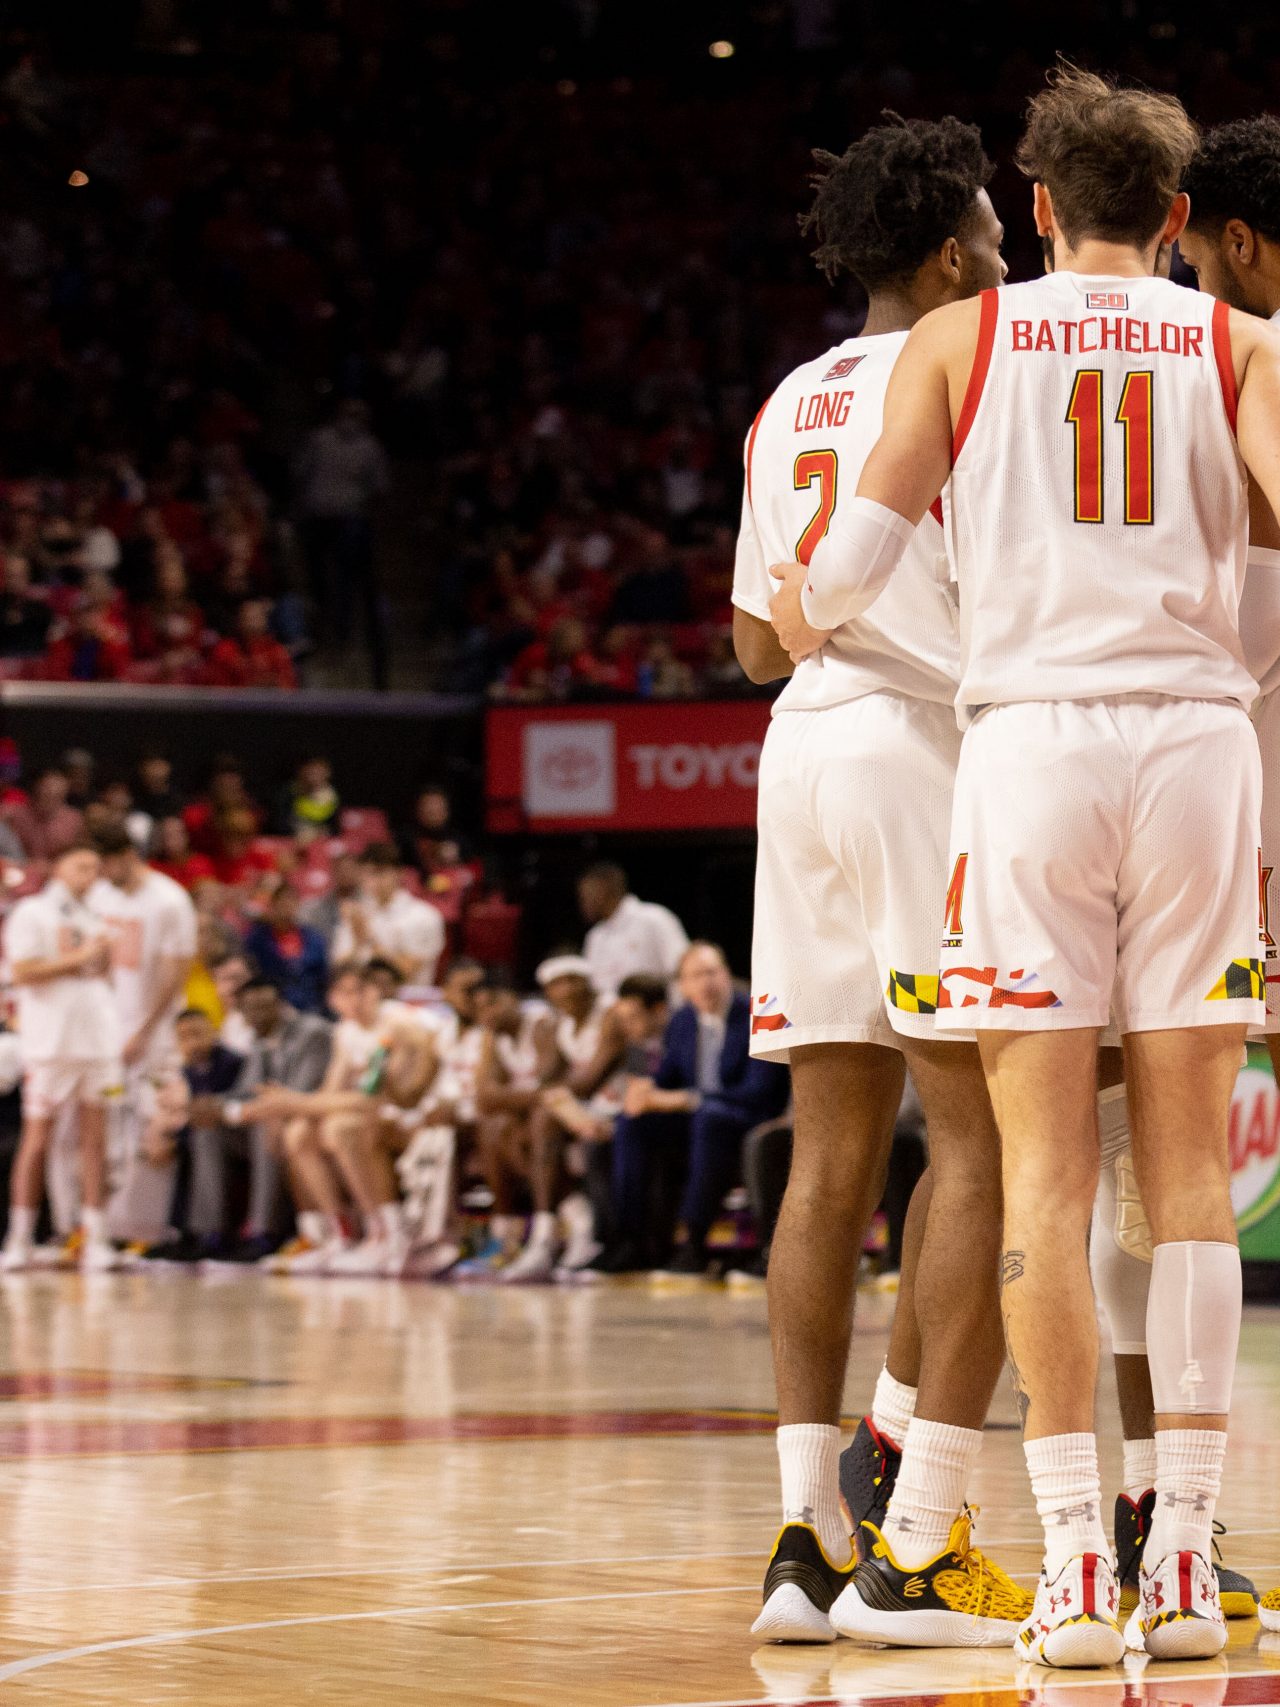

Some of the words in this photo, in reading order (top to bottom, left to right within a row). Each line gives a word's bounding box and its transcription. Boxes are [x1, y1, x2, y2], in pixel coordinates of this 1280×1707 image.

[1089, 293, 1126, 308] 50
[1011, 317, 1204, 357] BATCHELOR
[794, 390, 855, 433] LONG
[1064, 369, 1154, 525] 11
